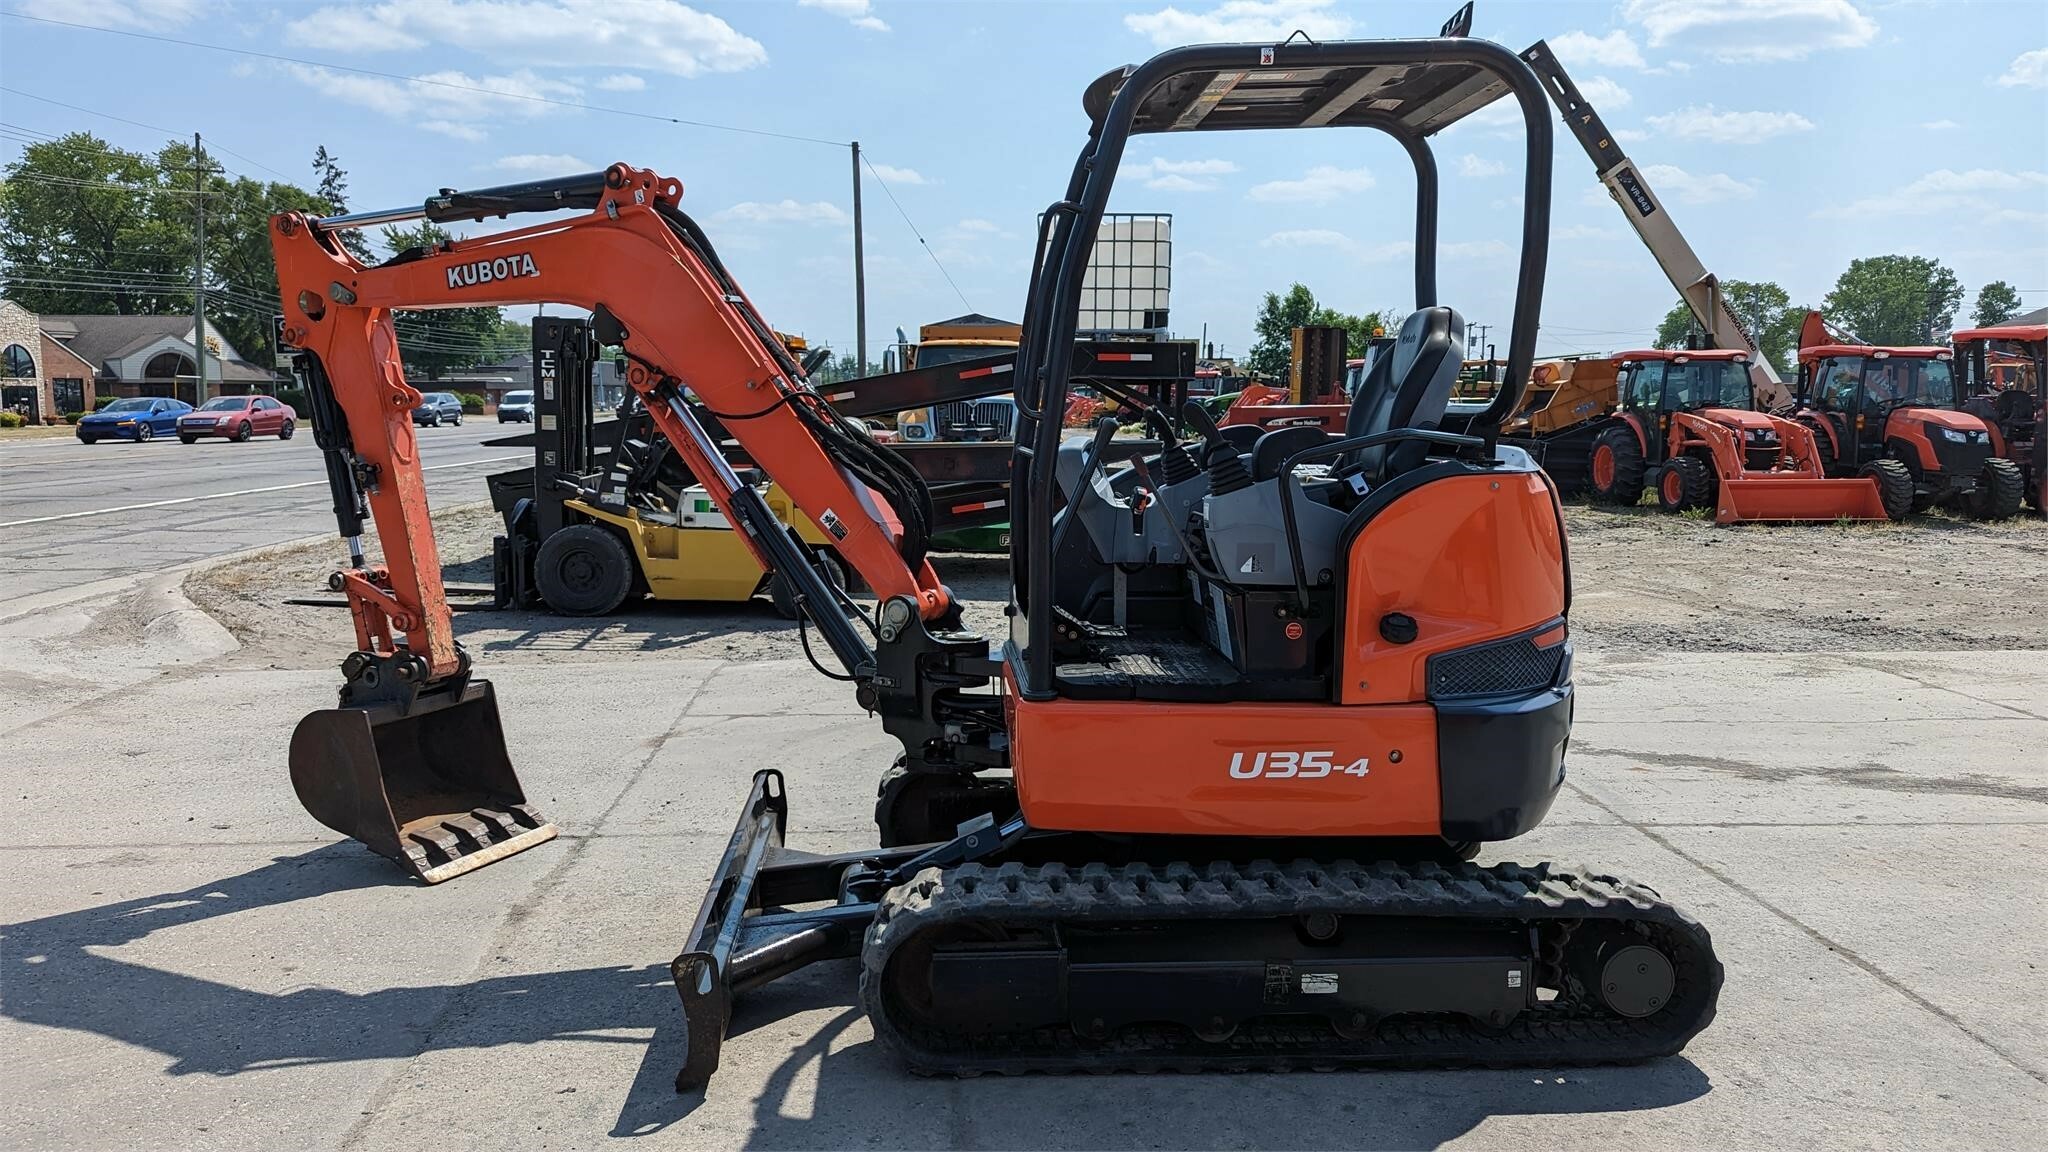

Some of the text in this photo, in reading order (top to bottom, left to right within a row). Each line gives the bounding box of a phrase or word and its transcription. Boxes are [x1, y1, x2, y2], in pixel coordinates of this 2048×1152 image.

[1582, 114, 1591, 124] A
[1599, 139, 1608, 149] B
[447, 254, 540, 288] KUBOTA
[541, 350, 556, 378] TCM
[1229, 751, 1370, 779] U35-4
